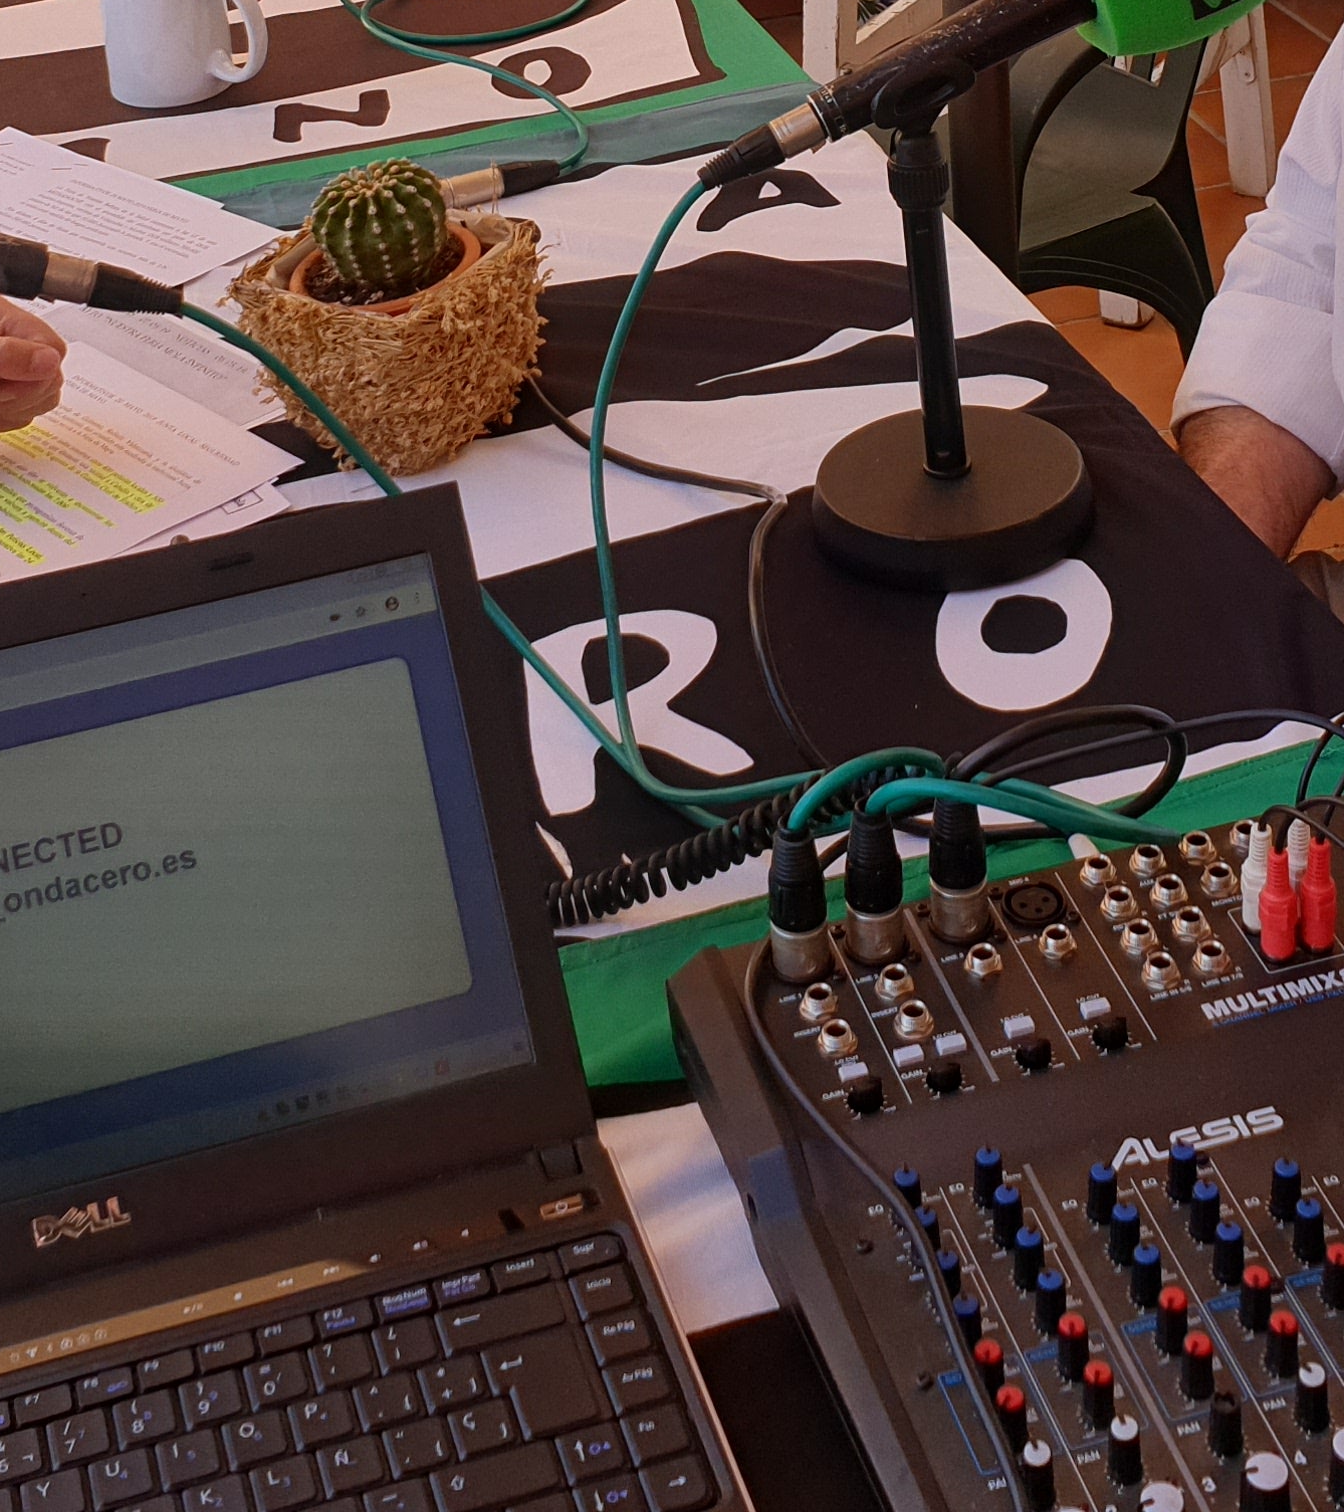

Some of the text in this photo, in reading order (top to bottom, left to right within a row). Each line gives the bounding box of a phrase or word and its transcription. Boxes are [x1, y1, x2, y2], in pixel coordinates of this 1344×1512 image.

[1211, 896, 1243, 907] MONITO
[871, 1006, 898, 1019] INSERT
[1220, 1009, 1266, 1026] CHANNEL
[794, 1026, 820, 1038] INSERT
[1066, 1026, 1090, 1036] GAIN
[990, 1047, 1012, 1057] GAIN
[900, 1069, 924, 1079] GAIN
[822, 1090, 845, 1100] GAIN
[1112, 1106, 1284, 1170] ALESIS
[948, 1182, 964, 1194] EQ
[1141, 1177, 1157, 1188] EQ
[1323, 1175, 1340, 1187] EQ
[1062, 1198, 1078, 1210] EQ
[1244, 1196, 1261, 1208] EQ
[868, 1204, 884, 1216] EQ
[30, 1195, 132, 1249] DELL
[573, 1242, 595, 1256] Supr
[506, 1258, 536, 1272] Insert
[586, 1276, 612, 1290] Inicio
[323, 1308, 343, 1322] F12
[264, 1324, 282, 1338] F11
[204, 1340, 226, 1354] F10
[144, 1360, 160, 1372] F9
[84, 1377, 100, 1390] F8
[24, 1393, 40, 1406] F7
[1262, 1398, 1287, 1412] PAN
[198, 1400, 210, 1415] 9
[304, 1402, 318, 1420] P
[131, 1419, 144, 1434] 8
[239, 1421, 255, 1438] O
[638, 1420, 655, 1434] Fin
[1176, 1422, 1202, 1436] PAN
[64, 1439, 76, 1455] 7
[1075, 1450, 1102, 1464] PAN
[1294, 1450, 1307, 1465] 4
[106, 1460, 119, 1478] U
[268, 1470, 280, 1487] L
[1202, 1476, 1216, 1494] 3
[36, 1480, 52, 1498] Y
[200, 1488, 214, 1504] K
